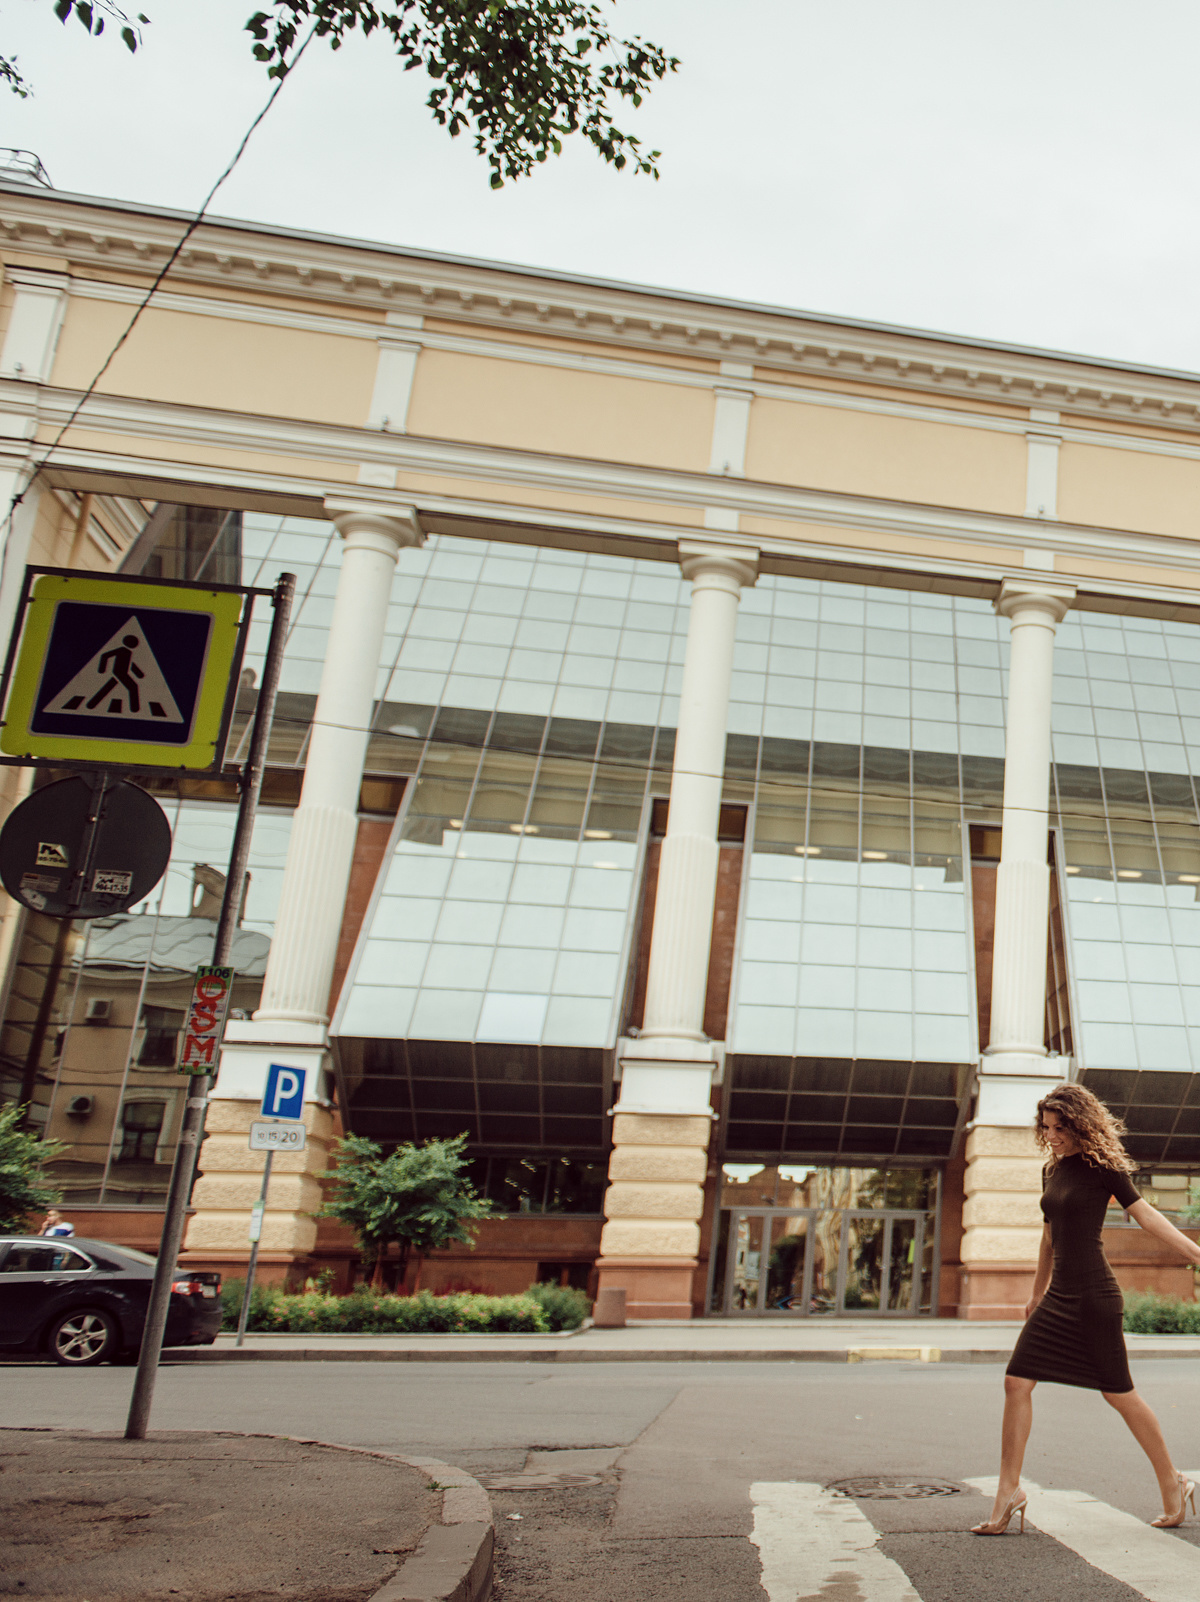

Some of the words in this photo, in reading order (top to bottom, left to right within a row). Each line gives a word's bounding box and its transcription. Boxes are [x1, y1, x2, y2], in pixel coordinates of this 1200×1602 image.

[199, 967, 230, 979] 1106
[273, 1070, 299, 1113] P
[268, 1131, 278, 1141] 15
[281, 1131, 298, 1143] 20
